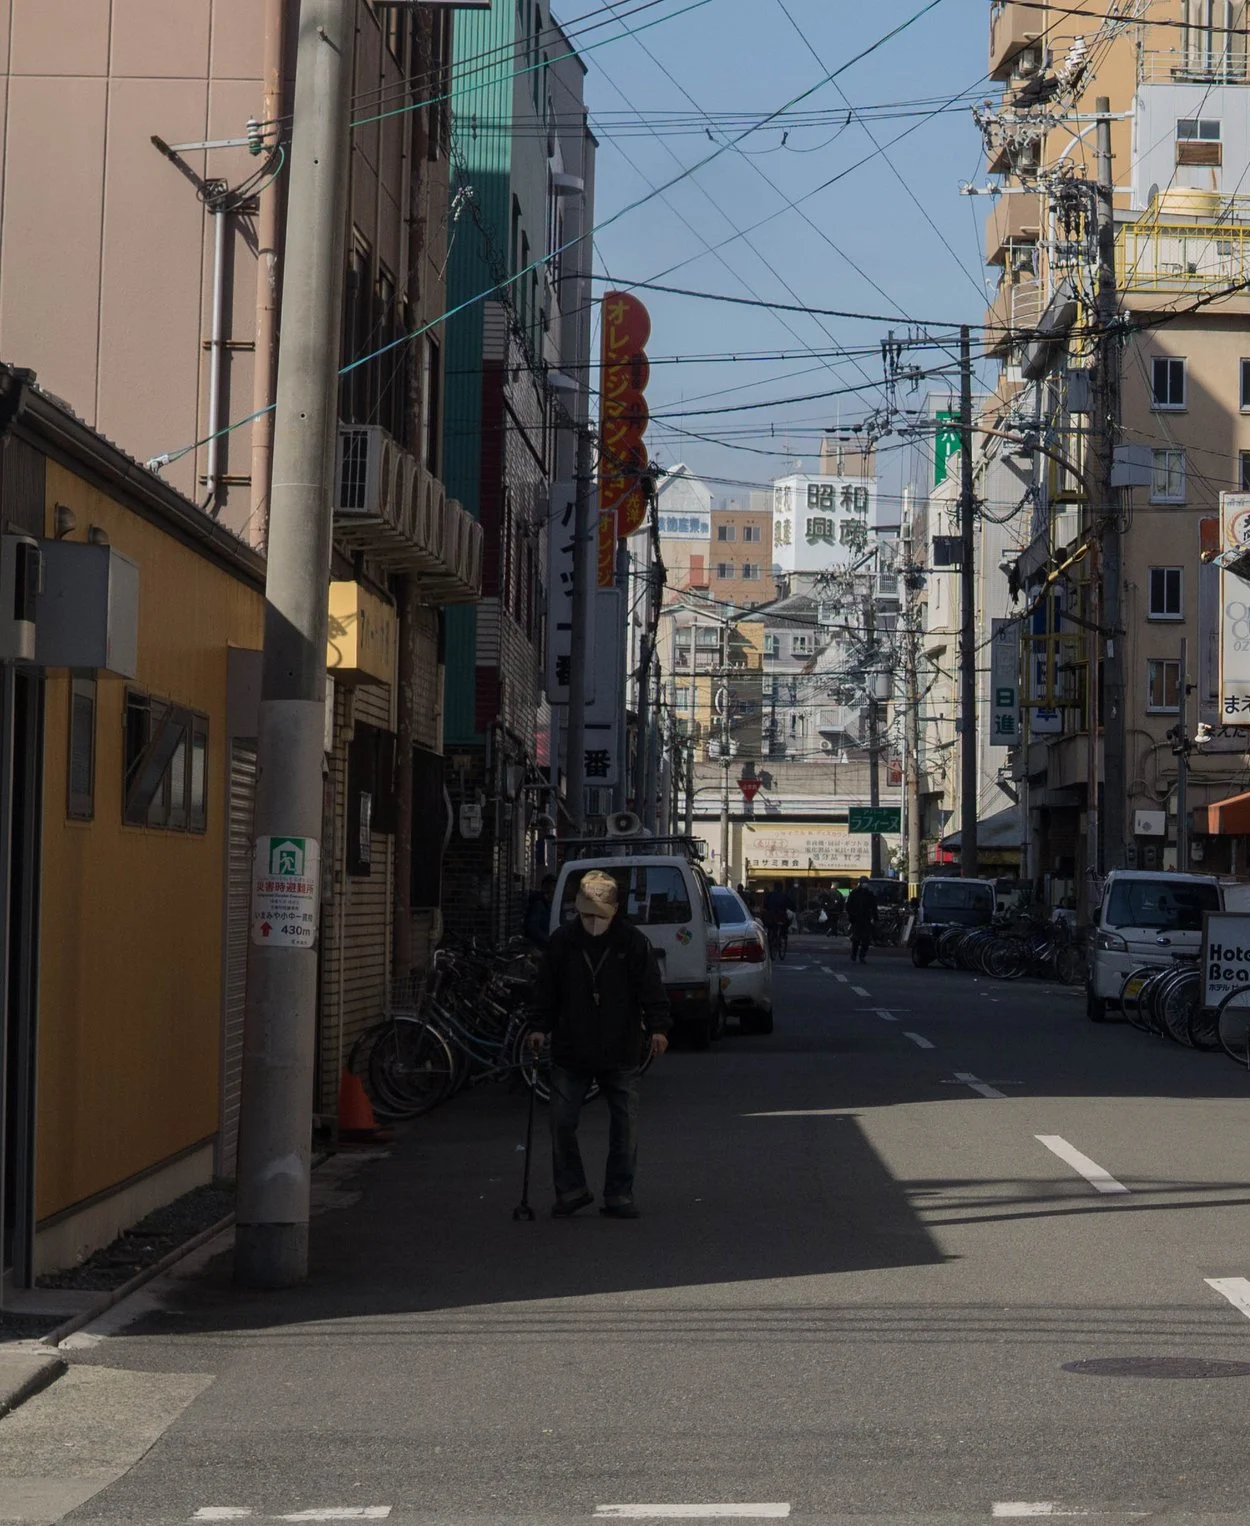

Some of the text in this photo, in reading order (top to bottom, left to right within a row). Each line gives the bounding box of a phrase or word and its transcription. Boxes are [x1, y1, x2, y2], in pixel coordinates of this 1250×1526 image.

[806, 484, 869, 514] 昭和
[583, 723, 612, 779] 一番
[850, 816, 899, 831] ラフィーヌ
[257, 880, 314, 894] 災害時避難所
[280, 925, 311, 936] 430m
